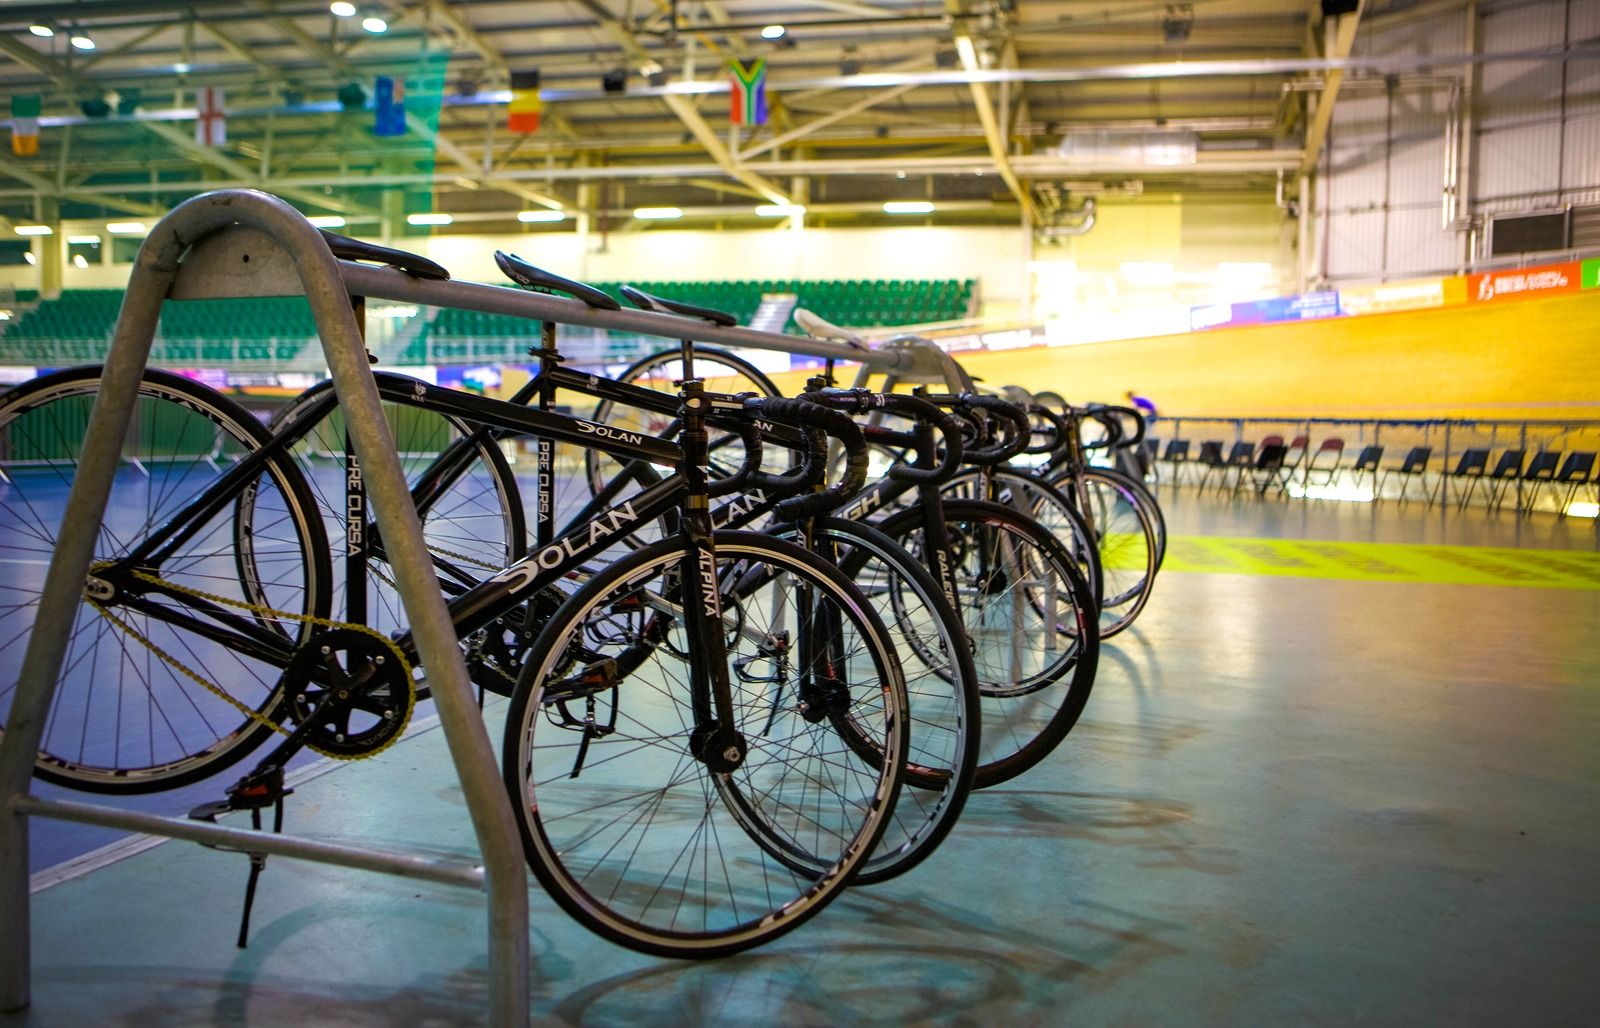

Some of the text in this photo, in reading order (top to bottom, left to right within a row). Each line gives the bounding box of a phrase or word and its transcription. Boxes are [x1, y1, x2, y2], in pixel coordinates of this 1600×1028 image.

[575, 420, 643, 446] DOLAN
[538, 441, 551, 524] PRE CURSA
[347, 494, 363, 558] CURSA
[489, 501, 639, 595] DOLAN
[697, 546, 717, 617] ALPINA
